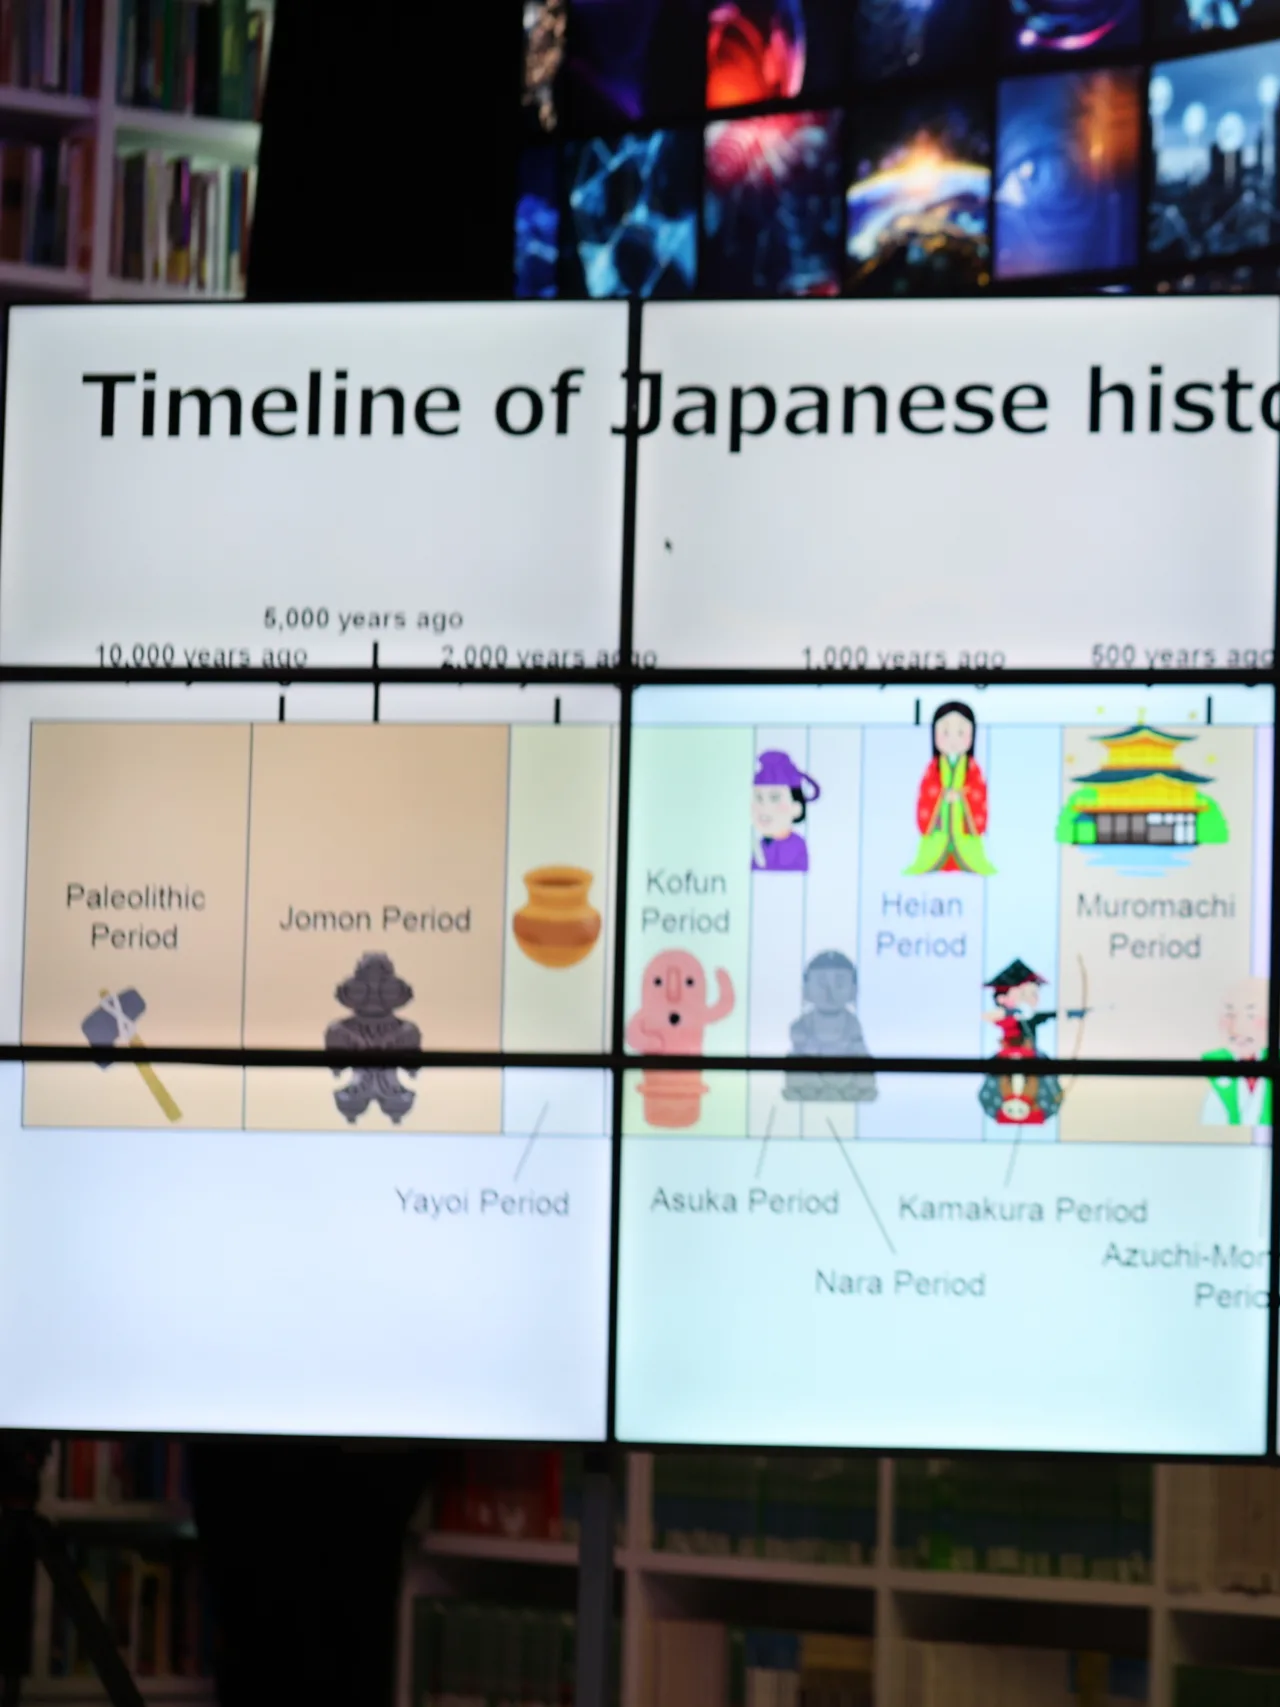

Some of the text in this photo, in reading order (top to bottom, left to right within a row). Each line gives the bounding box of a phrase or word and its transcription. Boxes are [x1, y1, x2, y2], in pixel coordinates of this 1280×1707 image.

[82, 369, 461, 437] Timeline
[494, 368, 585, 437] of
[611, 369, 1049, 454] Japanese
[264, 606, 463, 635] 5,000 years ago
[184, 648, 251, 681] years
[877, 650, 947, 684] years
[1091, 643, 1136, 669] 500
[1145, 648, 1216, 682] years
[647, 870, 727, 896] Kofun
[66, 883, 206, 912] Paleolithic
[882, 892, 963, 917] Heian
[1077, 893, 1236, 920] Muromachi
[280, 905, 471, 933] Jomon Period
[641, 908, 730, 934] Period
[91, 922, 179, 950] Period
[876, 932, 967, 958] Period
[1109, 932, 1202, 960] Period
[395, 1187, 570, 1217] Yayoi Period
[651, 1187, 839, 1215] Asuka Period
[900, 1194, 1148, 1225] Kamakura Period
[816, 1269, 986, 1298] Nara Period
